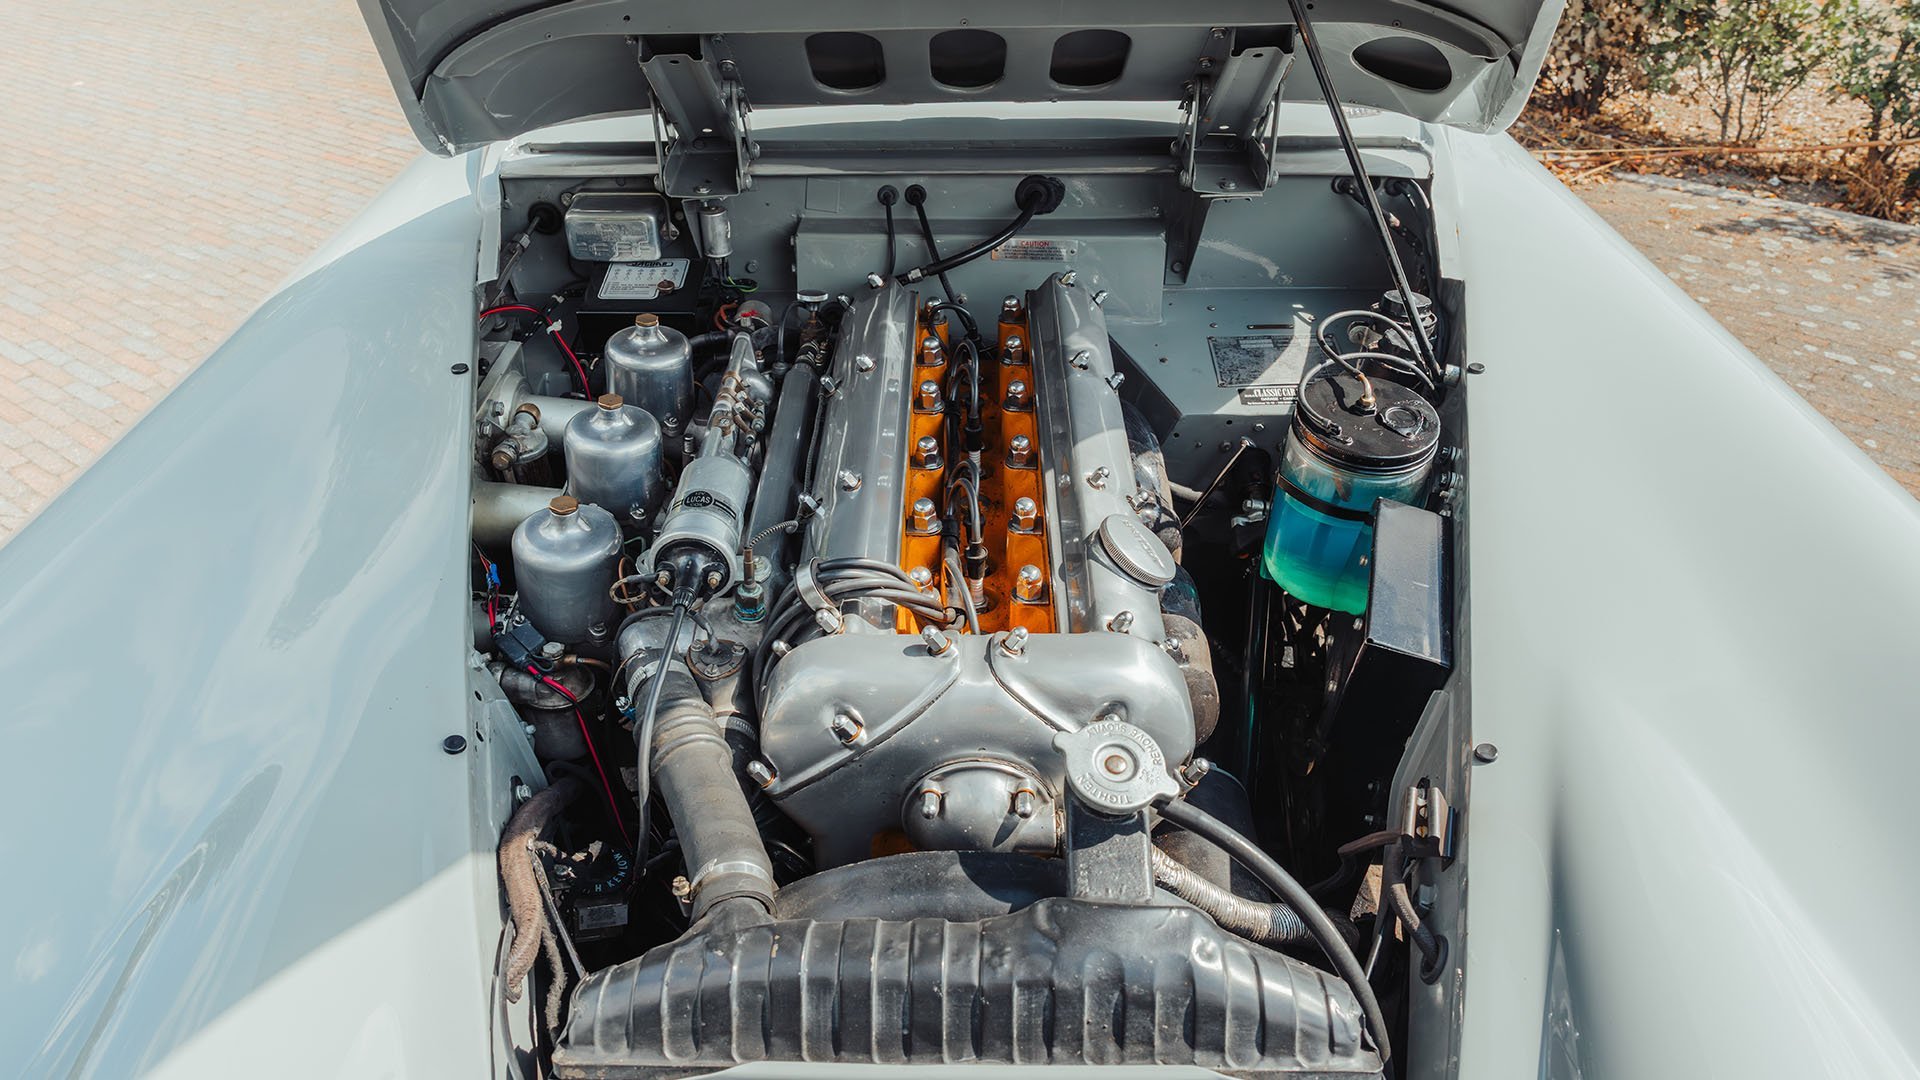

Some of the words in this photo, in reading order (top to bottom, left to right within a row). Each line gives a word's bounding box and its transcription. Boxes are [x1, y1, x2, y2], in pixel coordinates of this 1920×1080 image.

[1254, 388, 1282, 397] CLASSIC
[1282, 388, 1296, 397] CAR
[686, 495, 711, 504] LUCAS
[1130, 728, 1163, 766] REMOVE
[1076, 774, 1133, 804] TIGHTEN
